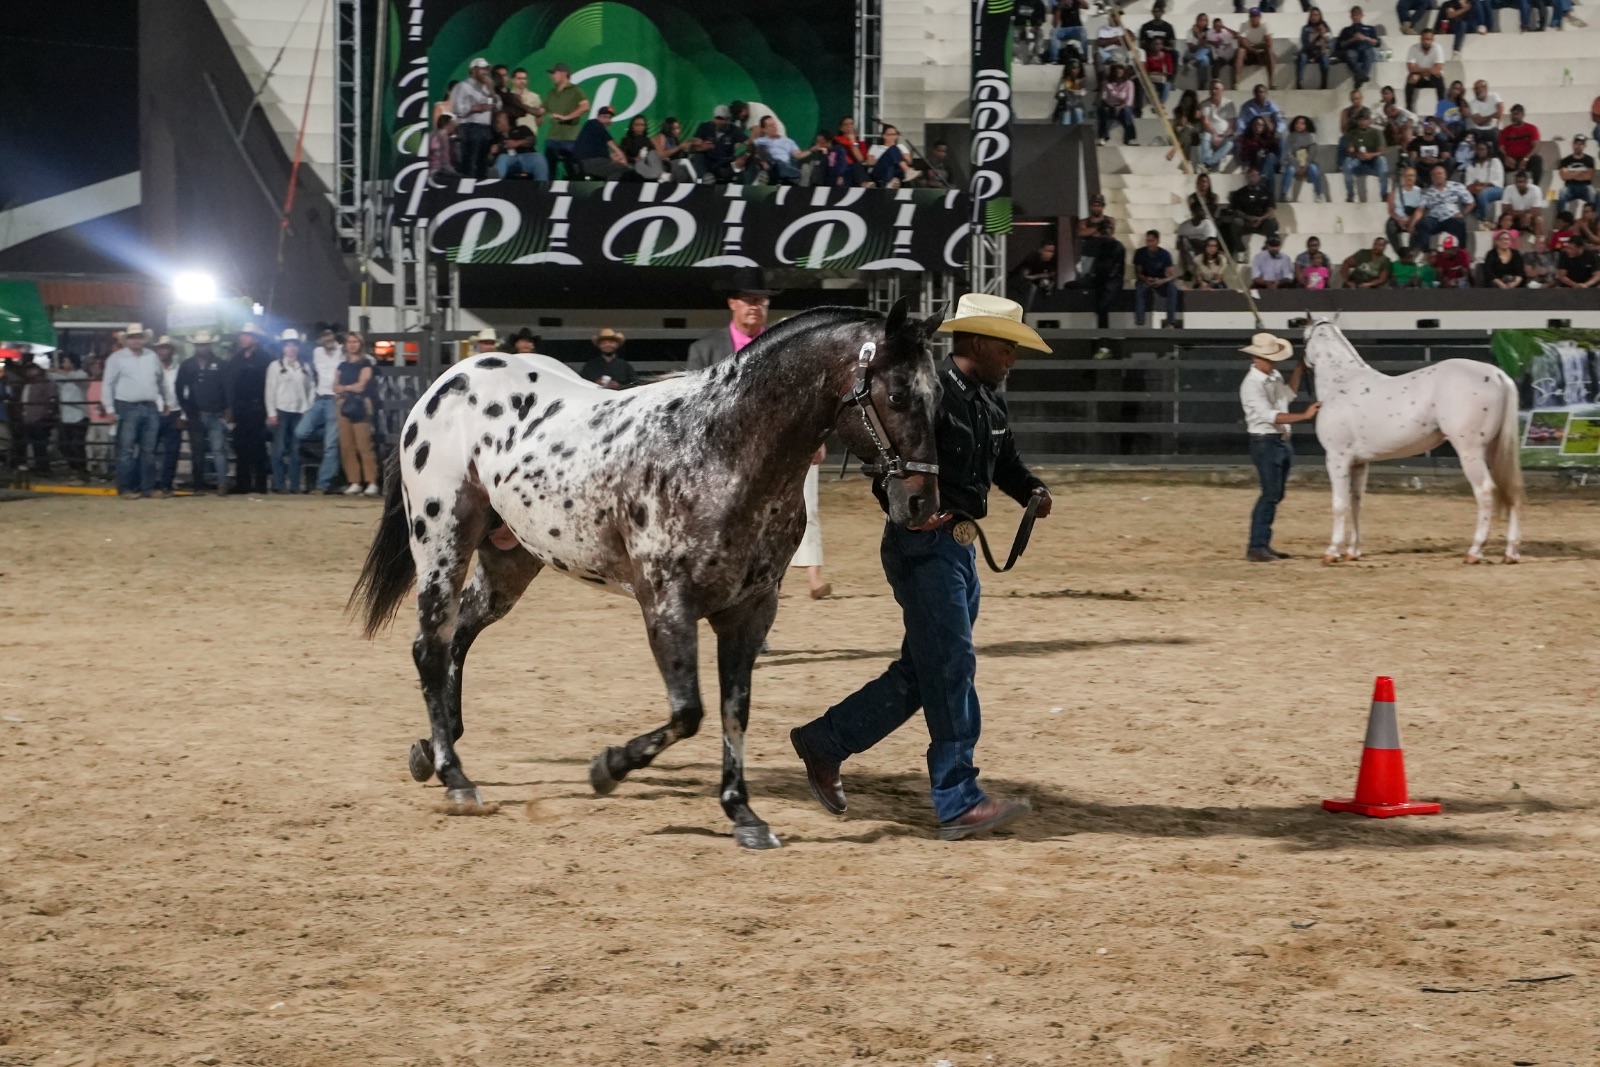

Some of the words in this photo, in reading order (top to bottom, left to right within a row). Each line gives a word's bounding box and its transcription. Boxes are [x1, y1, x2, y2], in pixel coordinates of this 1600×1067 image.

[570, 62, 658, 122] P
[969, 169, 1004, 223] P
[427, 197, 522, 263] P
[601, 205, 697, 266] P
[774, 209, 868, 269] P
